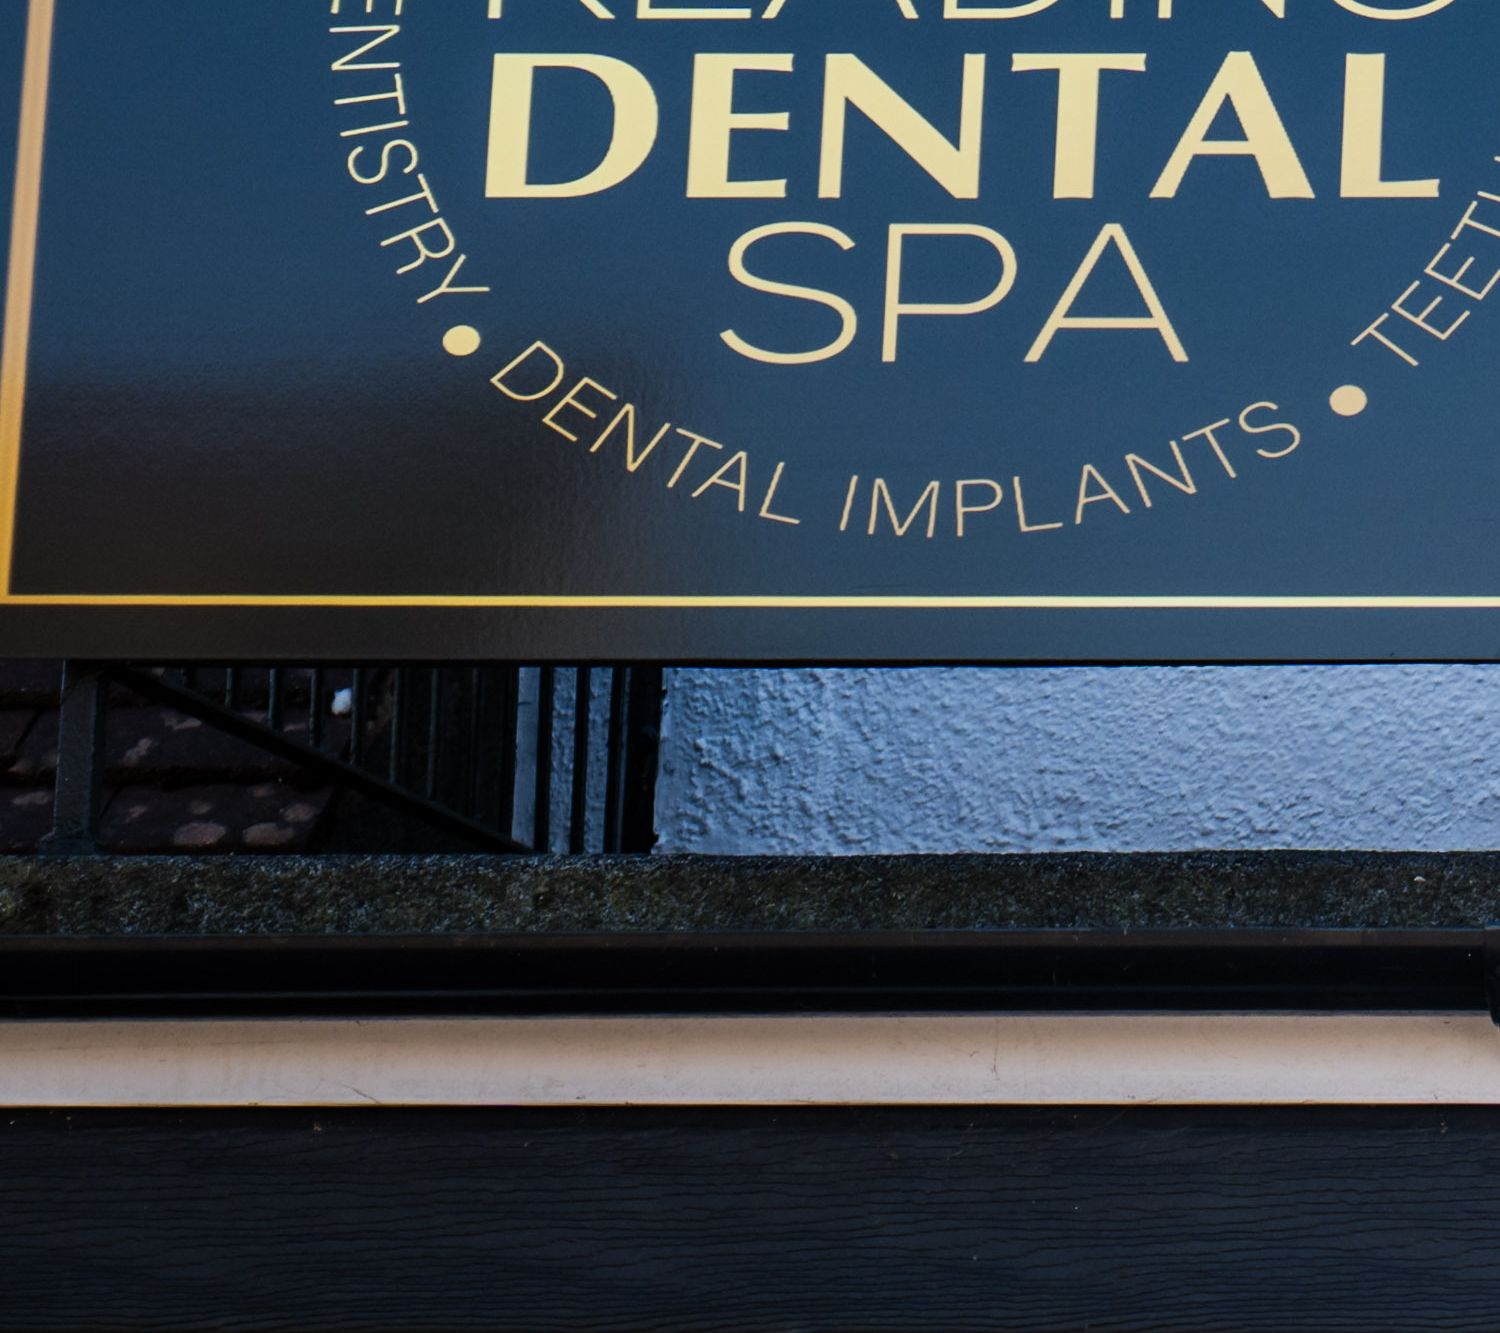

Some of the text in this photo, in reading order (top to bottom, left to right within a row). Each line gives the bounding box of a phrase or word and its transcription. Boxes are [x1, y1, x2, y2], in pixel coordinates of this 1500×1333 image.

[484, 50, 1441, 200] DENTAL
[719, 221, 1189, 365] SPA
[489, 340, 1301, 539] DENTAL IMPLANTS
